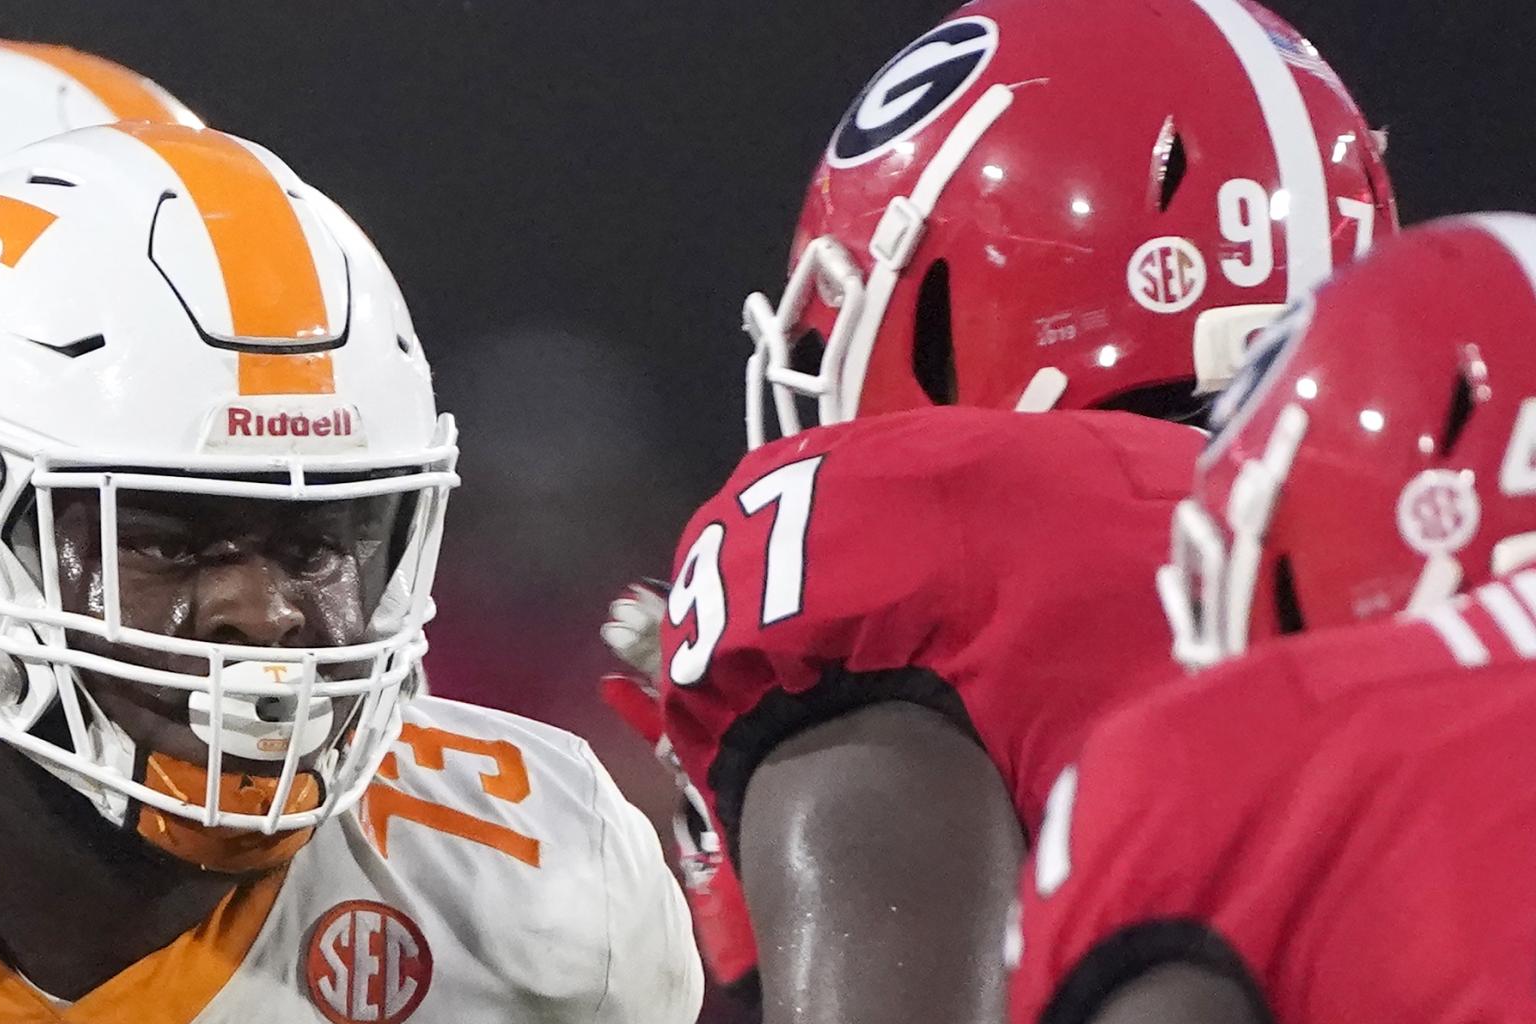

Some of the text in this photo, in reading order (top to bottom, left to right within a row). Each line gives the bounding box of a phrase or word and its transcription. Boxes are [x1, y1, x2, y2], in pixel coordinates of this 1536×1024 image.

[1137, 246, 1195, 303] SEC
[227, 407, 352, 437] Riddell
[667, 451, 826, 686] 97
[356, 722, 541, 868] 73
[319, 911, 419, 1020] SEC
